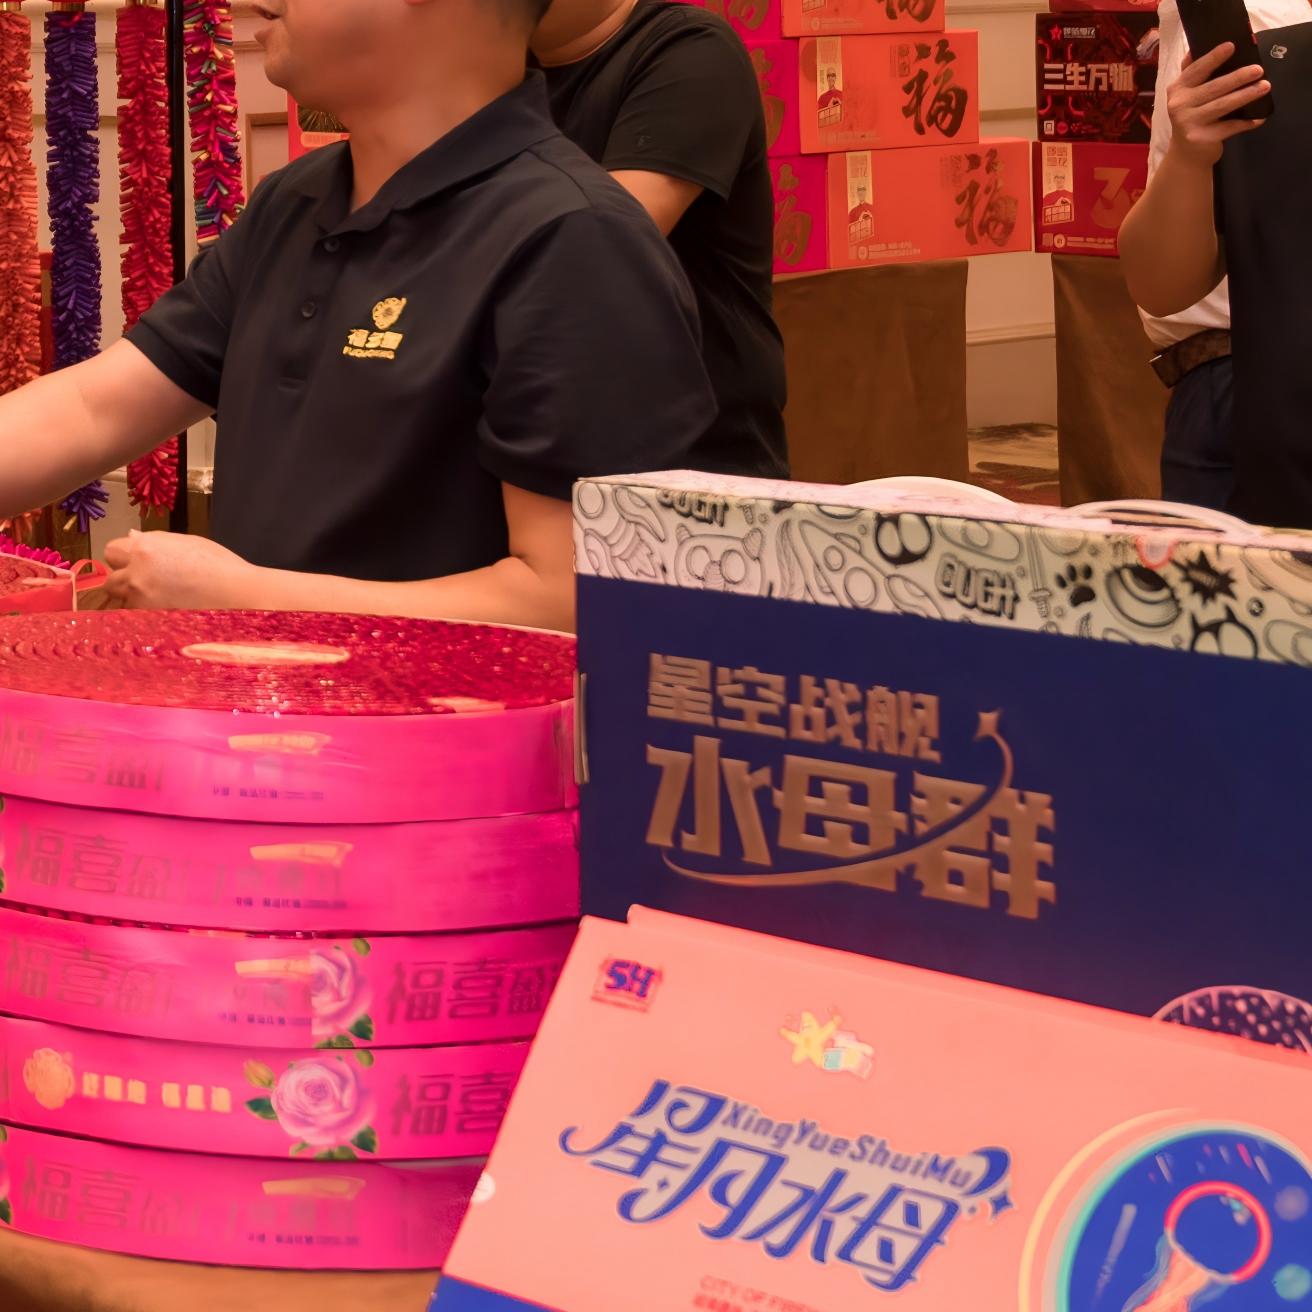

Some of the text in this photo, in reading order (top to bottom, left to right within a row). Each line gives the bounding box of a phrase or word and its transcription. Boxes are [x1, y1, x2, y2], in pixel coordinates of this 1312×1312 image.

[901, 38, 969, 138] 福
[1043, 62, 1134, 92] 三生万物
[954, 147, 1019, 248] 福
[646, 652, 943, 764] 星空战舰
[645, 734, 1058, 920] 水母群
[559, 1078, 962, 1292] 星月水母
[721, 1100, 975, 1190] XingYueShuiMu
